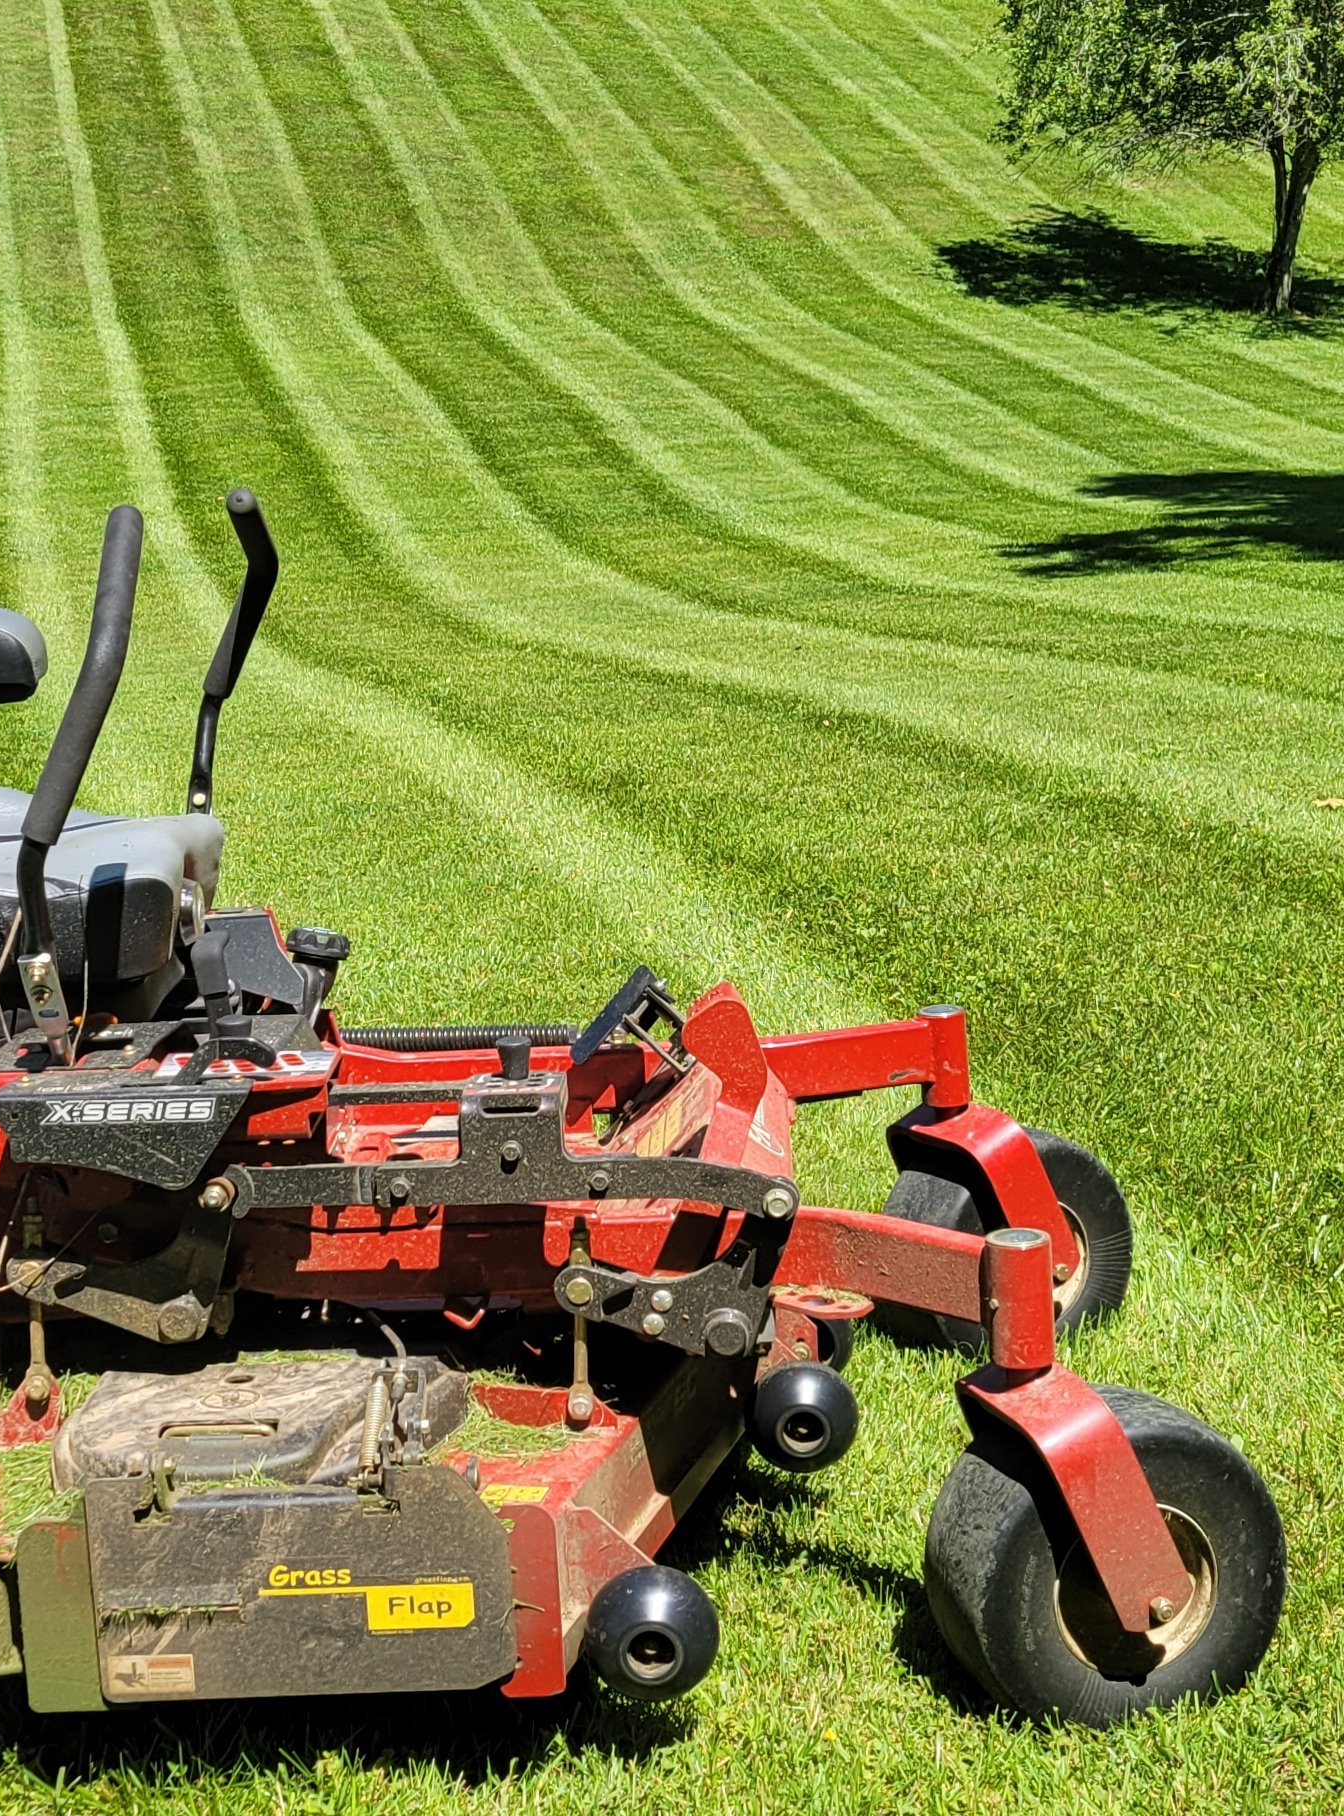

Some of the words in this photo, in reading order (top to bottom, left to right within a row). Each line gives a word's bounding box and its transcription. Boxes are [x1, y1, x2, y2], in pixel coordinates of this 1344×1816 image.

[44, 1099, 214, 1123] X-SERIES
[268, 1564, 352, 1587] Grass
[388, 1596, 453, 1619] Flap
